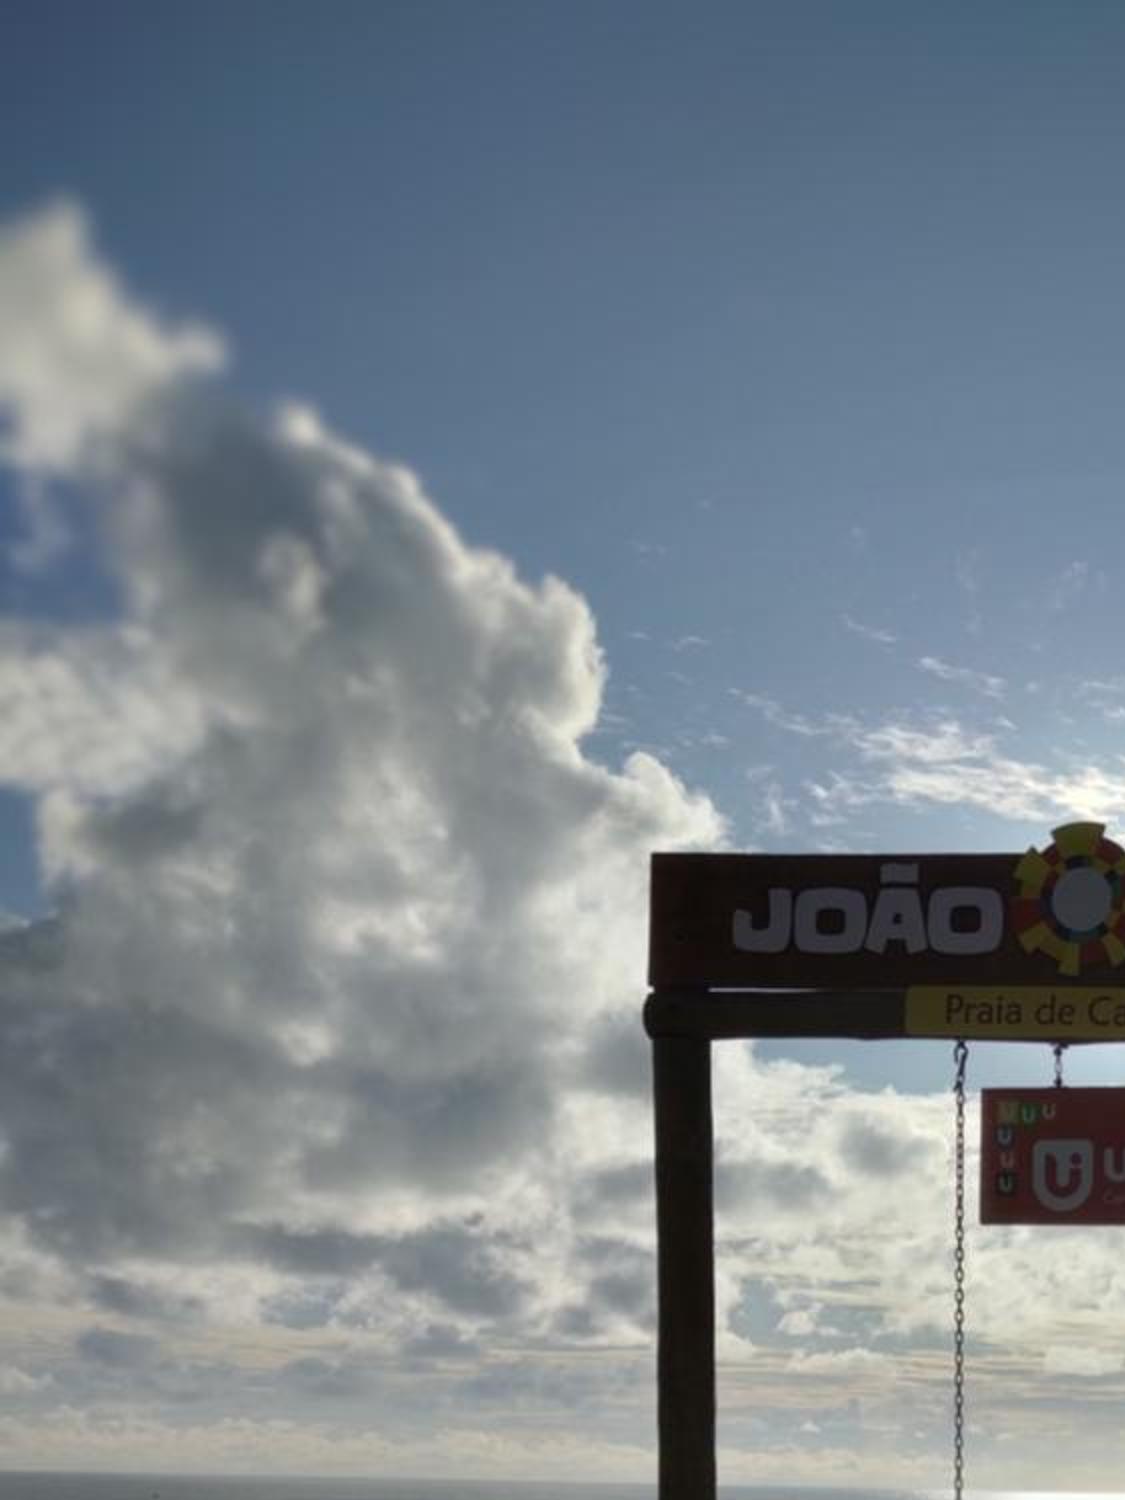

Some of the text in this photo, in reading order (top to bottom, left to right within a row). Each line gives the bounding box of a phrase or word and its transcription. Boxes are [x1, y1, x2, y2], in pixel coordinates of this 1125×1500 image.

[732, 862, 1004, 956] JOÃO
[945, 994, 1022, 1026] Praia
[1035, 995, 1075, 1027] de
